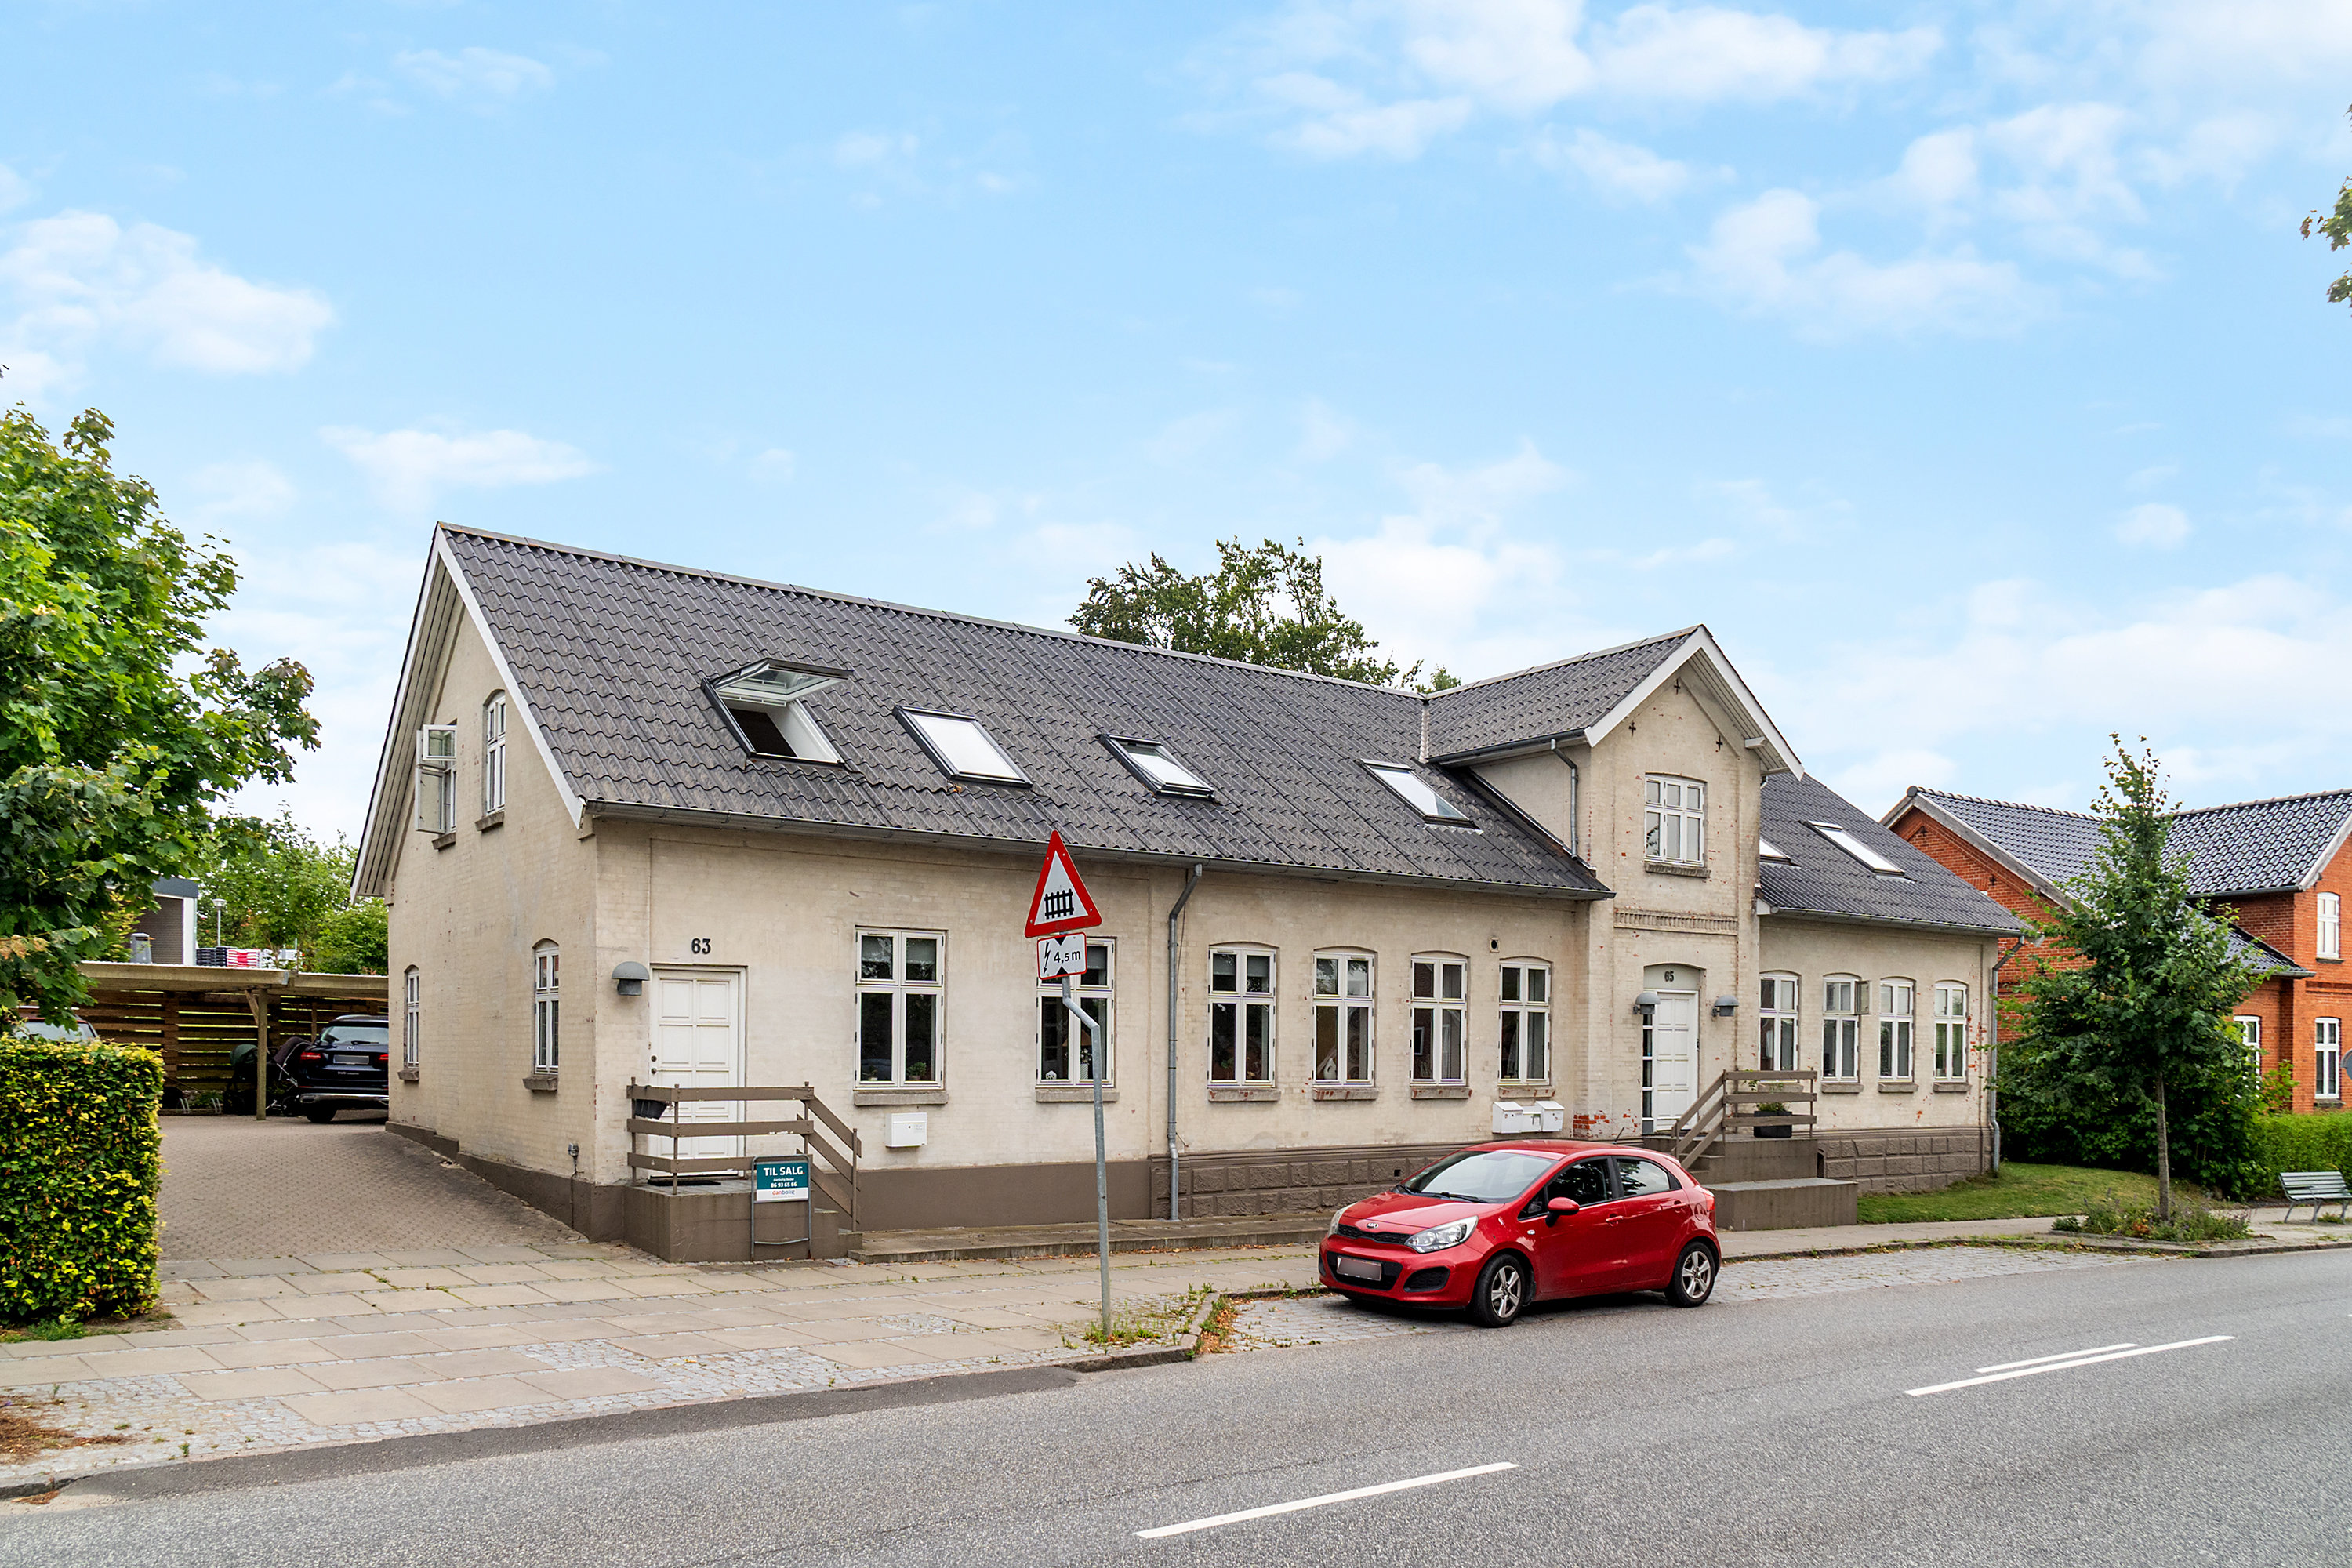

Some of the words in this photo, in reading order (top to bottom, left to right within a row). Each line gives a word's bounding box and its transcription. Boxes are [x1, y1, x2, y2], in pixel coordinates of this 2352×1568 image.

[691, 938, 711, 954] 63
[1054, 951, 1069, 964] 4,5
[1072, 950, 1081, 961] m
[1664, 971, 1675, 982] 65
[764, 1167, 778, 1176] TIL
